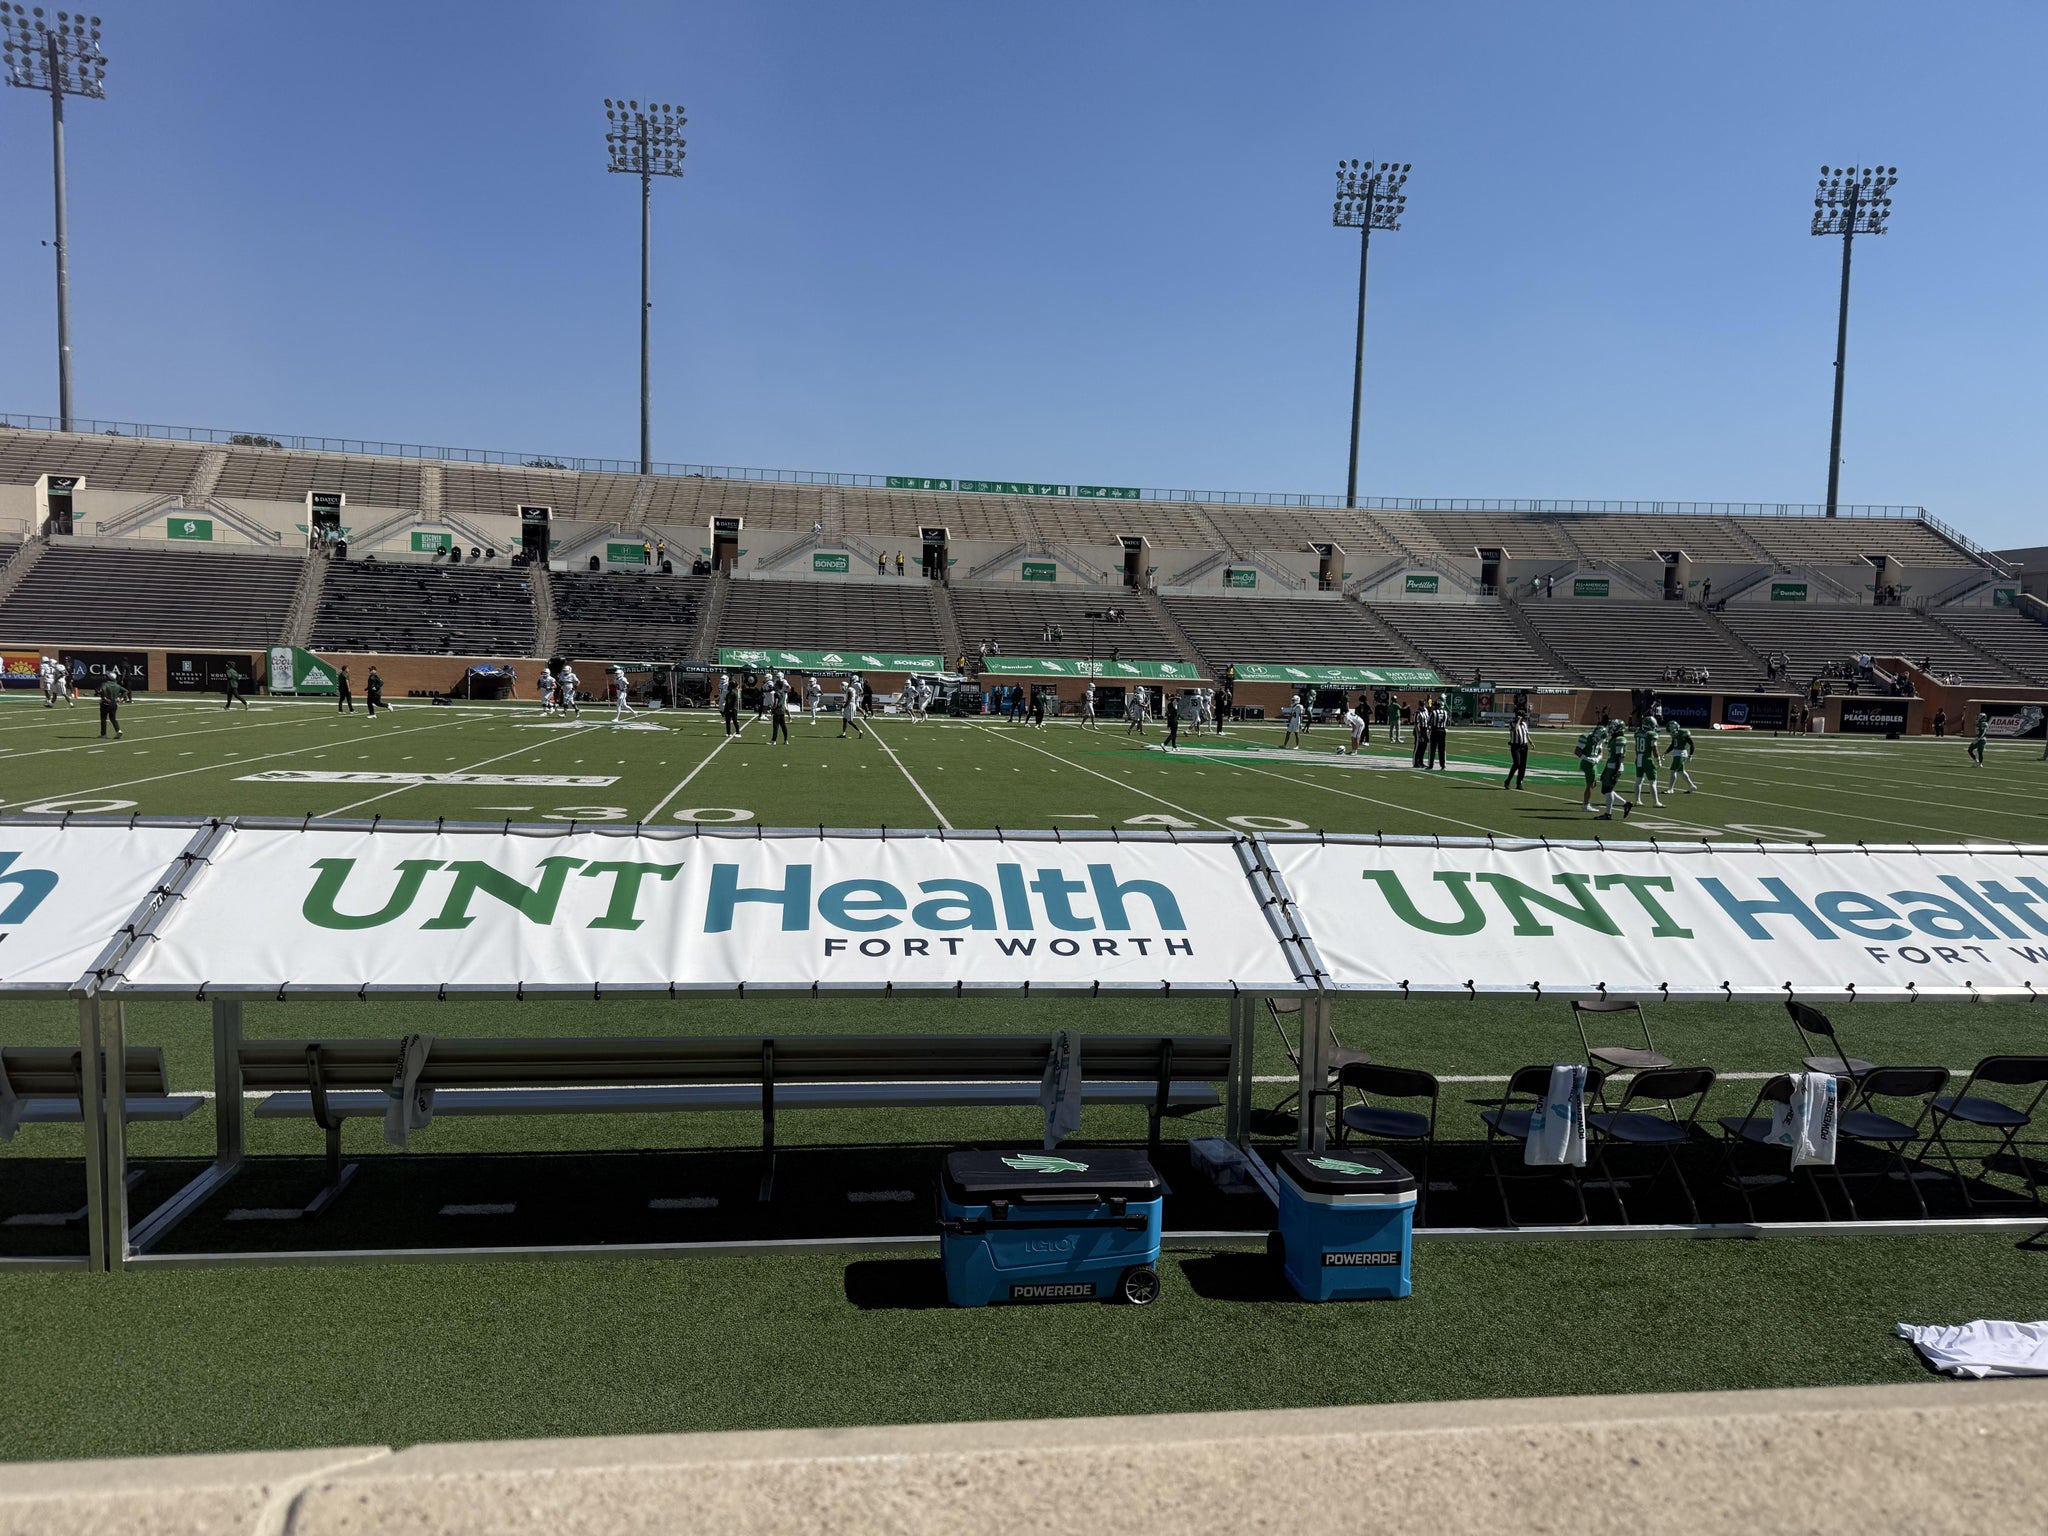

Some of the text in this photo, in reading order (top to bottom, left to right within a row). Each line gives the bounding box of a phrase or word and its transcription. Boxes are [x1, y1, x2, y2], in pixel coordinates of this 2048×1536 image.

[815, 560, 847, 568] BONDED
[1407, 579, 1437, 589] Portillo's
[89, 664, 145, 677] CLAK
[894, 660, 936, 668] BONDED
[1663, 707, 1708, 717] Domino's
[1844, 713, 1904, 723] PEACH COBBLER
[335, 773, 612, 786] DATCU
[302, 856, 1188, 933] UNT Health
[1362, 870, 2048, 941] UNT Healt
[824, 936, 1196, 958] FORT WORTH
[1865, 946, 1995, 966] FORT
[1820, 1096, 1837, 1141] POWERADE
[1325, 1252, 1399, 1266] POWERADE
[1014, 1283, 1092, 1299] POWERADE
